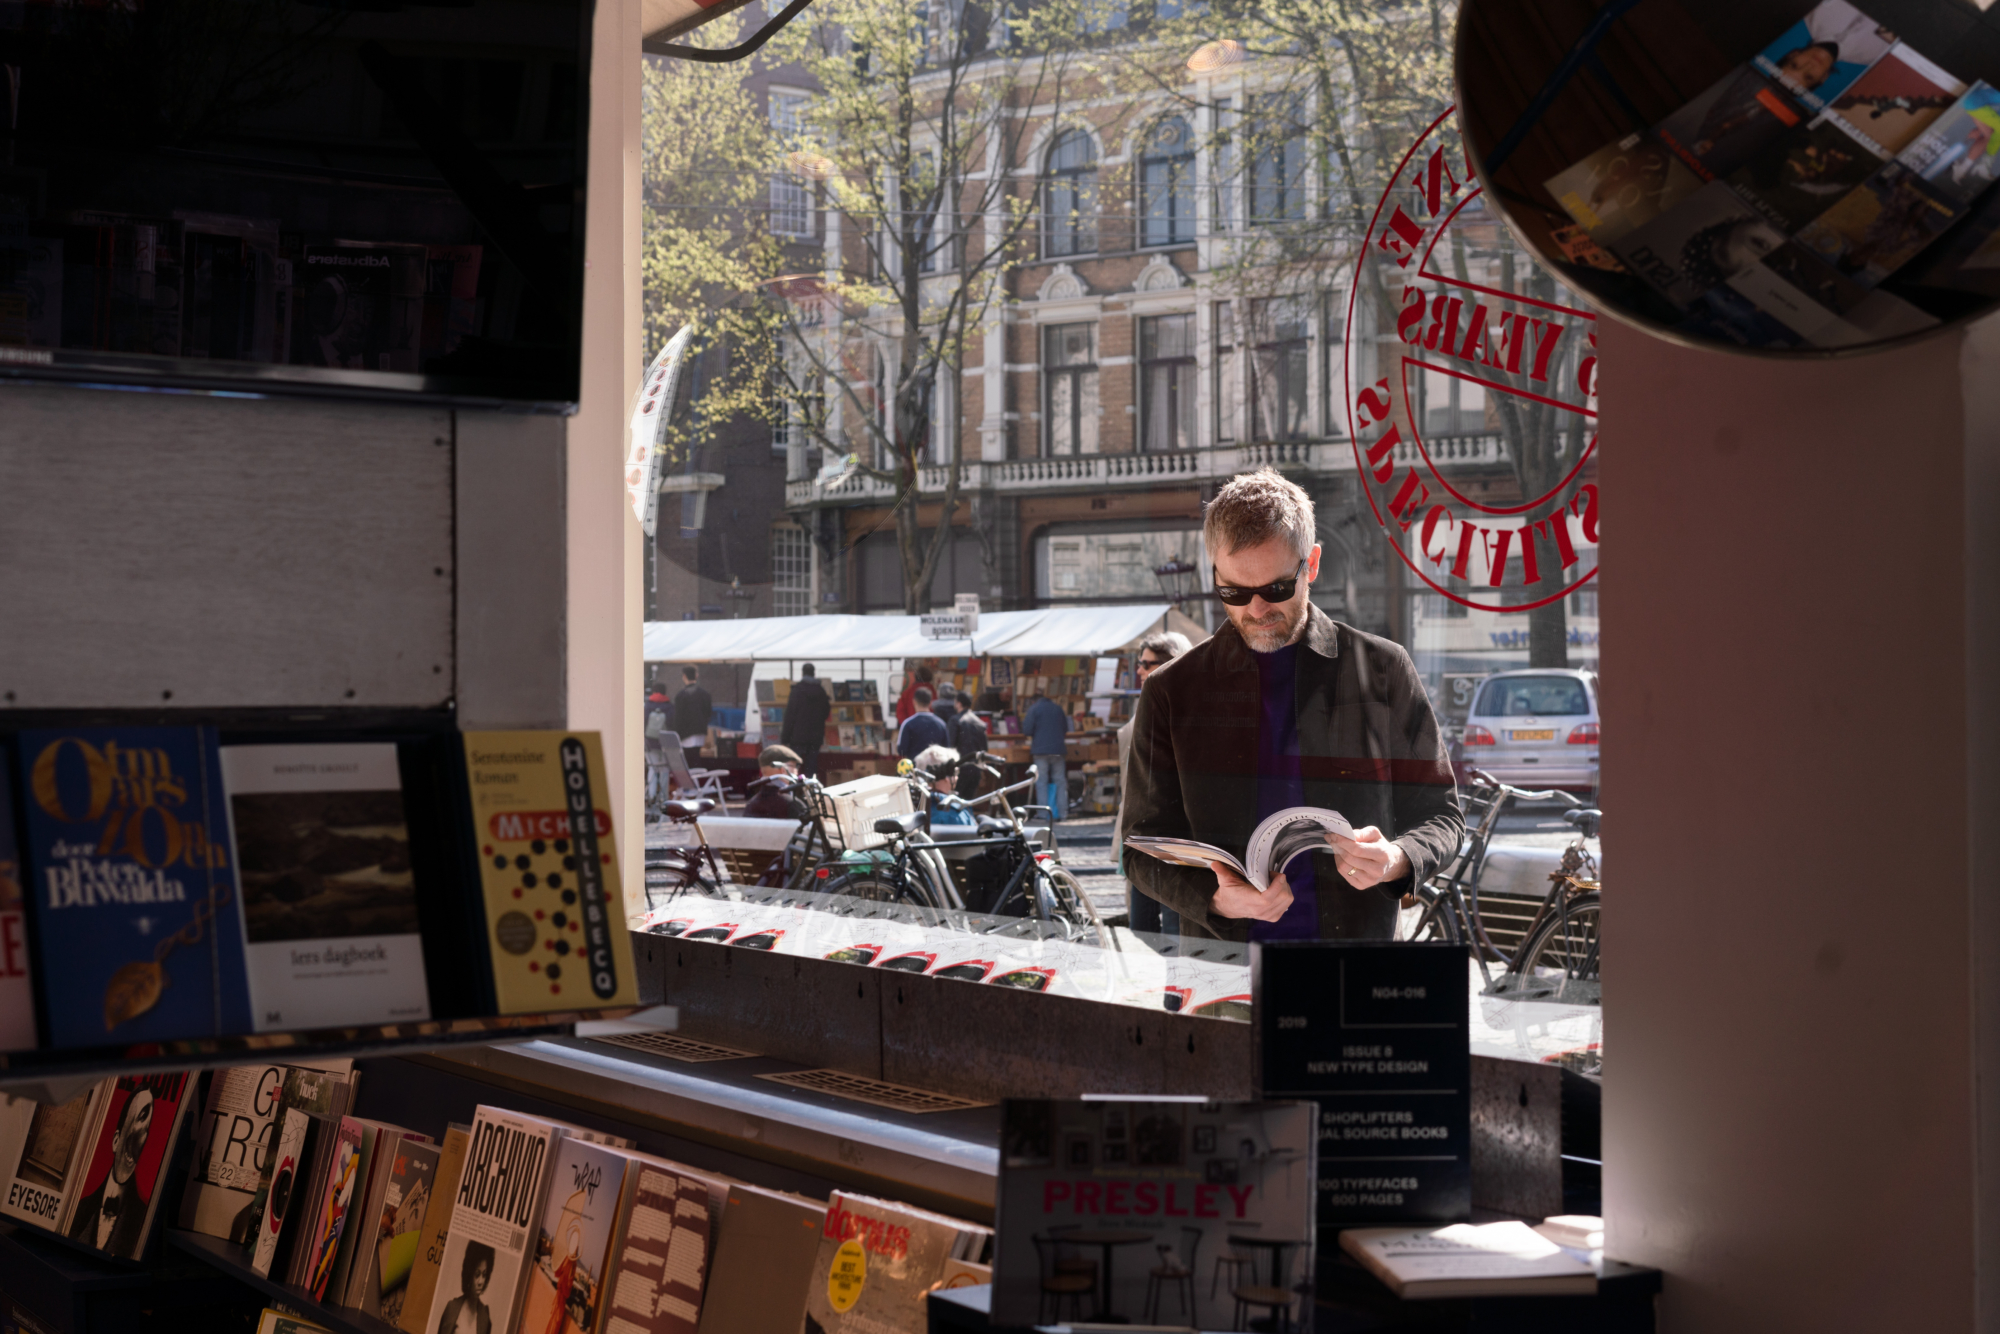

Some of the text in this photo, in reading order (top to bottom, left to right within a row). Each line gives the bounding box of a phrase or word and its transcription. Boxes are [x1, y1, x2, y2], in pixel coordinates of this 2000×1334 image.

[471, 749, 546, 767] Serotonine
[474, 769, 520, 785] Roman
[52, 838, 97, 859] door
[70, 857, 142, 884] Peter
[562, 745, 614, 992] HOUELLEBECQ
[45, 866, 186, 909] Buwalda
[323, 943, 387, 968] dagboek
[1277, 1016, 1308, 1029] 2019
[1343, 1046, 1381, 1058] ISSUE
[1307, 1060, 1429, 1074] NEW TYPE DESIGN
[1323, 1111, 1414, 1124] SHOPLIFTERS
[1343, 1127, 1399, 1139] SOURCE
[1401, 1126, 1448, 1139] BOOKS
[219, 1167, 233, 1181] 22
[457, 1119, 547, 1229] ARCHIVIO
[1341, 1177, 1419, 1190] TYPEFACES
[8, 1183, 61, 1222] EYESORE
[1043, 1179, 1256, 1219] PRESLEY
[1359, 1193, 1404, 1205] PAGES
[823, 1196, 911, 1261] domus
